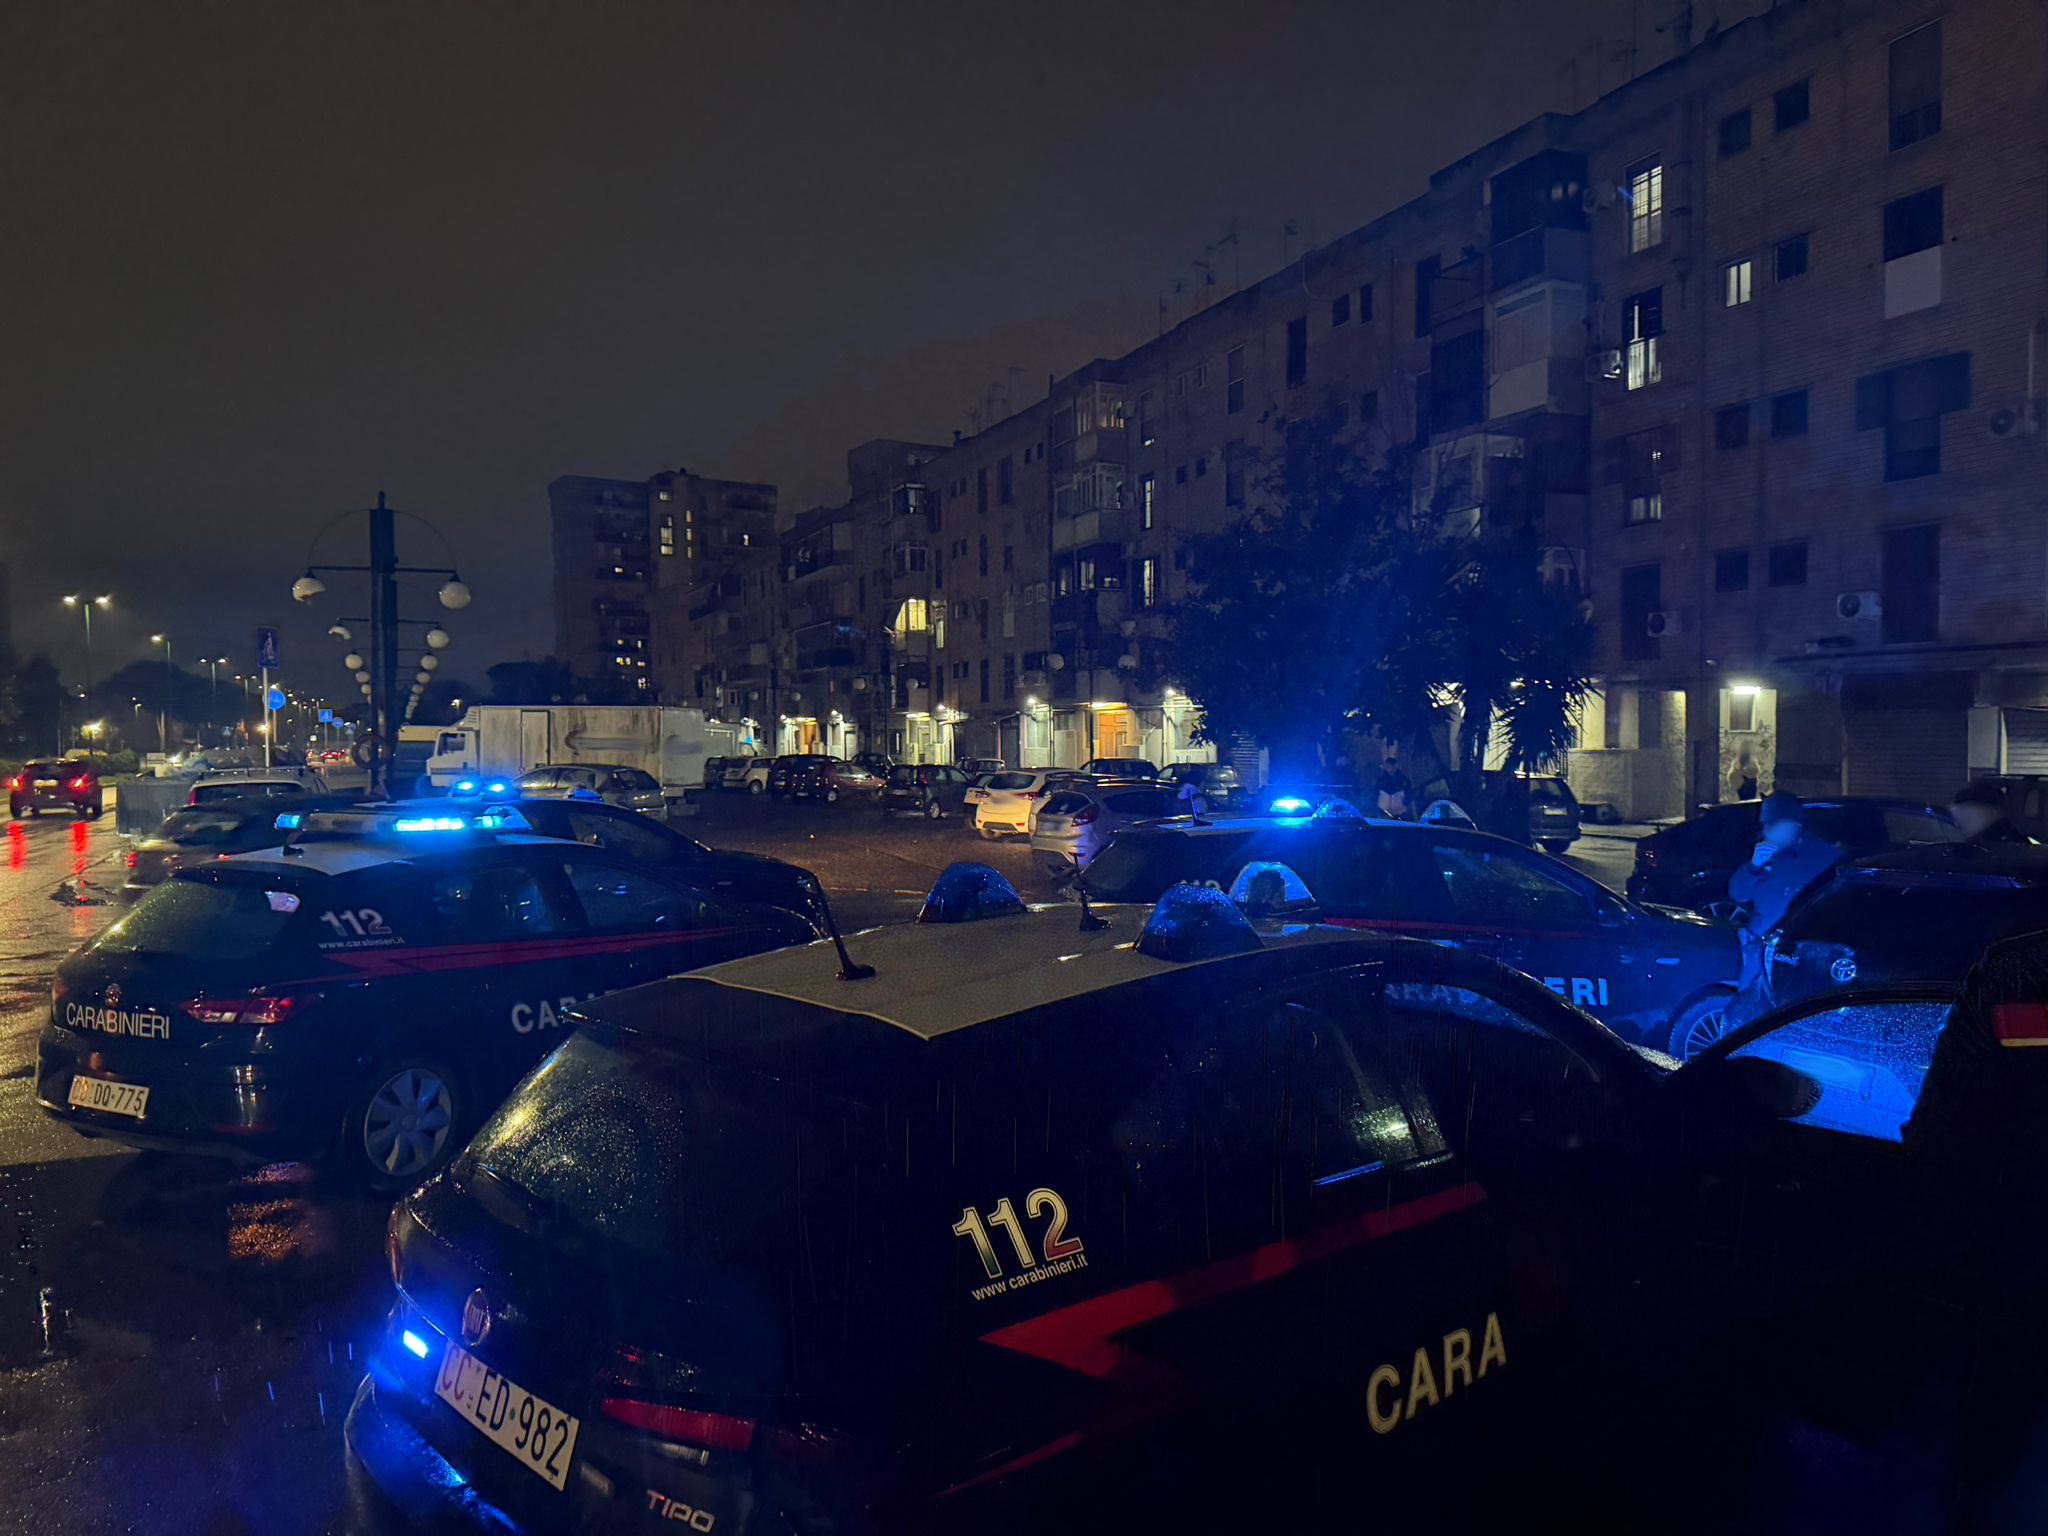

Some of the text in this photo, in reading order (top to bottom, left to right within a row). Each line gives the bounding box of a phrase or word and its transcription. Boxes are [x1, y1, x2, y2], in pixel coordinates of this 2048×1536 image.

[320, 908, 393, 937] 112
[66, 1002, 171, 1040] CARABINIERI
[952, 1188, 1084, 1280] 112
[1366, 1312, 1507, 1435] CARA
[646, 1488, 717, 1534] TIPO
